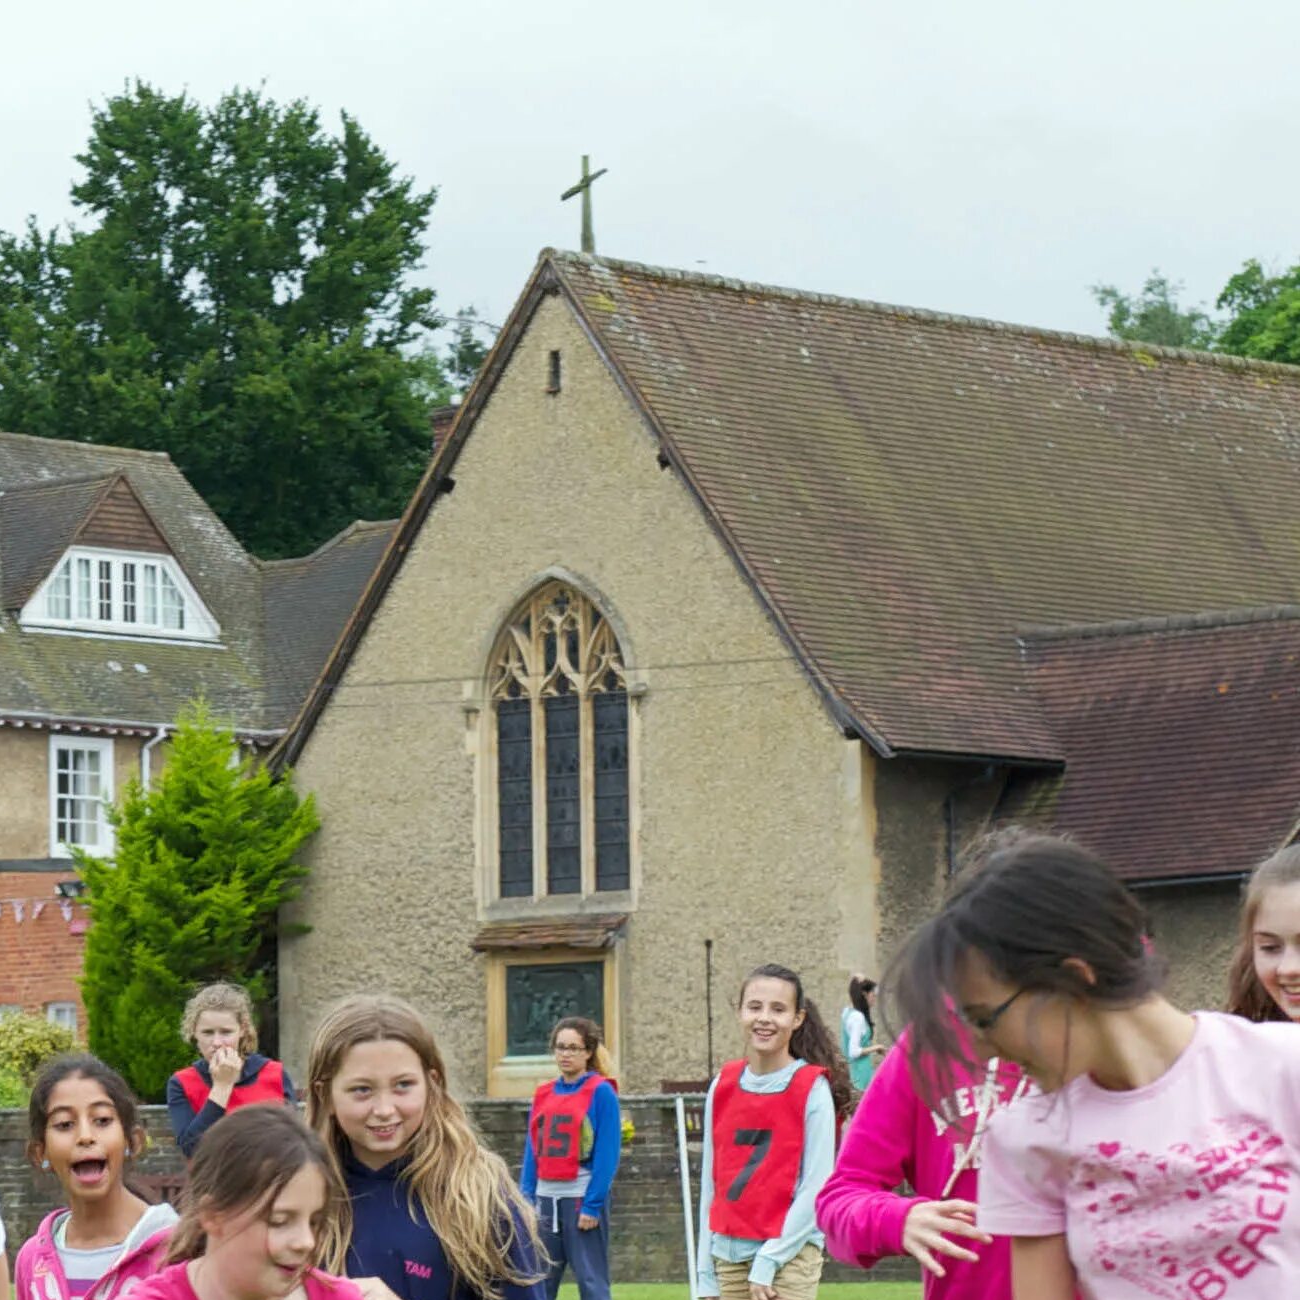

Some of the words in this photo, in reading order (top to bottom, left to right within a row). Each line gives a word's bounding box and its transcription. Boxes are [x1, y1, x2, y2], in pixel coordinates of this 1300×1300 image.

[536, 1112, 573, 1157] 15
[725, 1128, 773, 1202] 7
[404, 1260, 432, 1279] TAM
